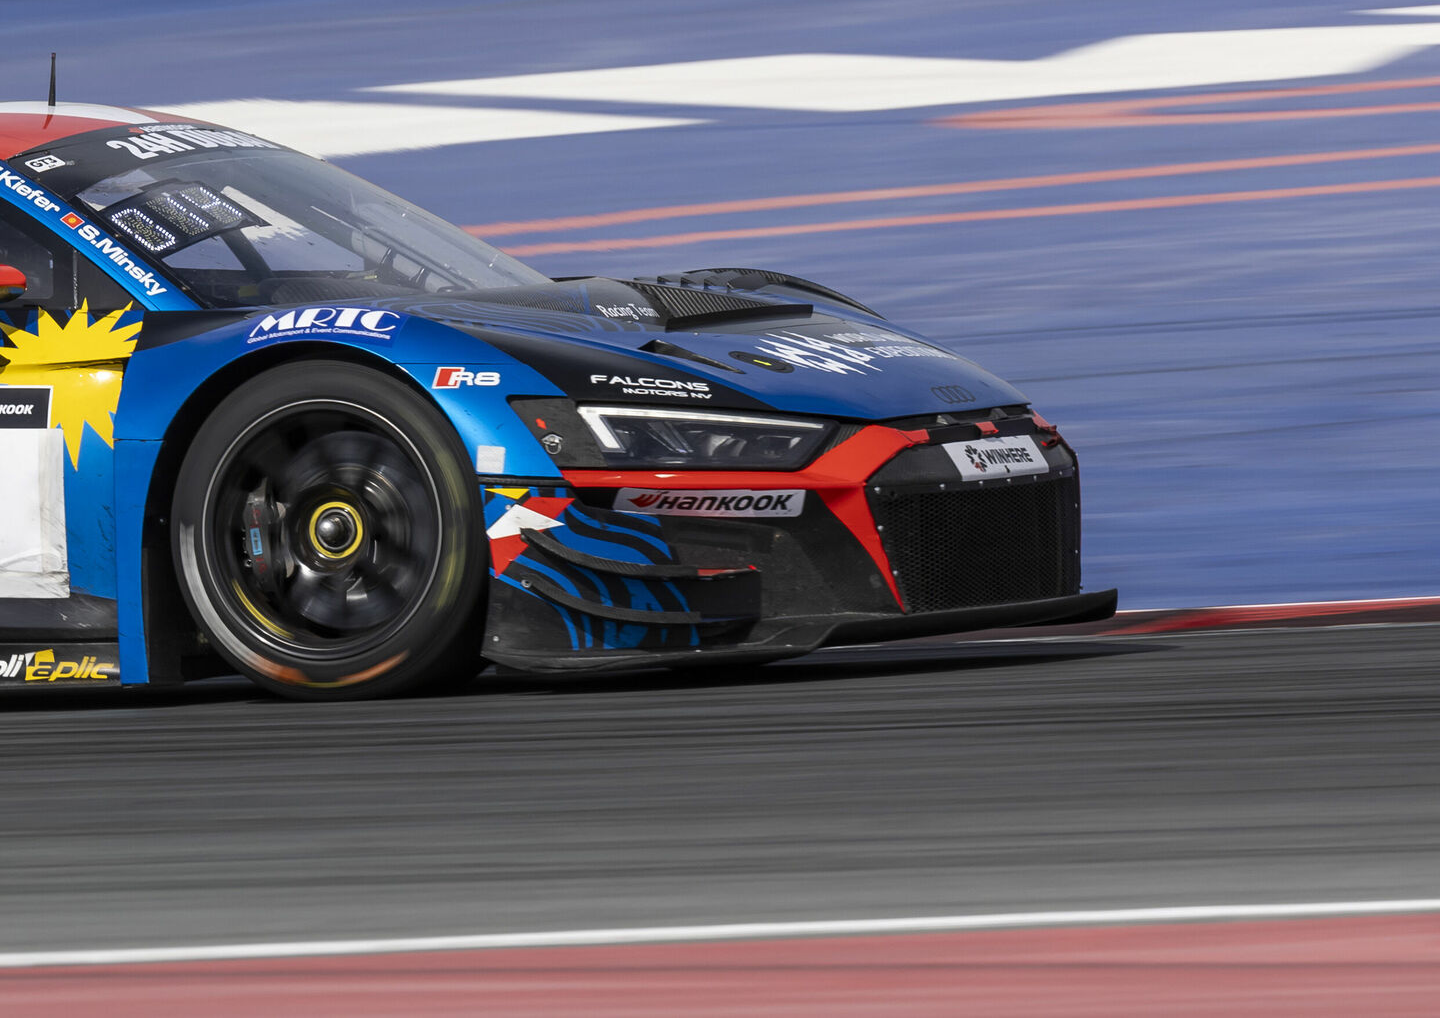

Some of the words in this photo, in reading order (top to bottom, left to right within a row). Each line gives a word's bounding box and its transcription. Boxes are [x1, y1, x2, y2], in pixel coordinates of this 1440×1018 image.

[78, 223, 167, 297] S.Minsky
[595, 304, 639, 320] Racing
[627, 303, 660, 318] Team
[249, 307, 400, 338] MRTC
[590, 374, 710, 391] FALCONS
[622, 387, 689, 398] MOTORS
[981, 447, 1034, 464] WINHERE
